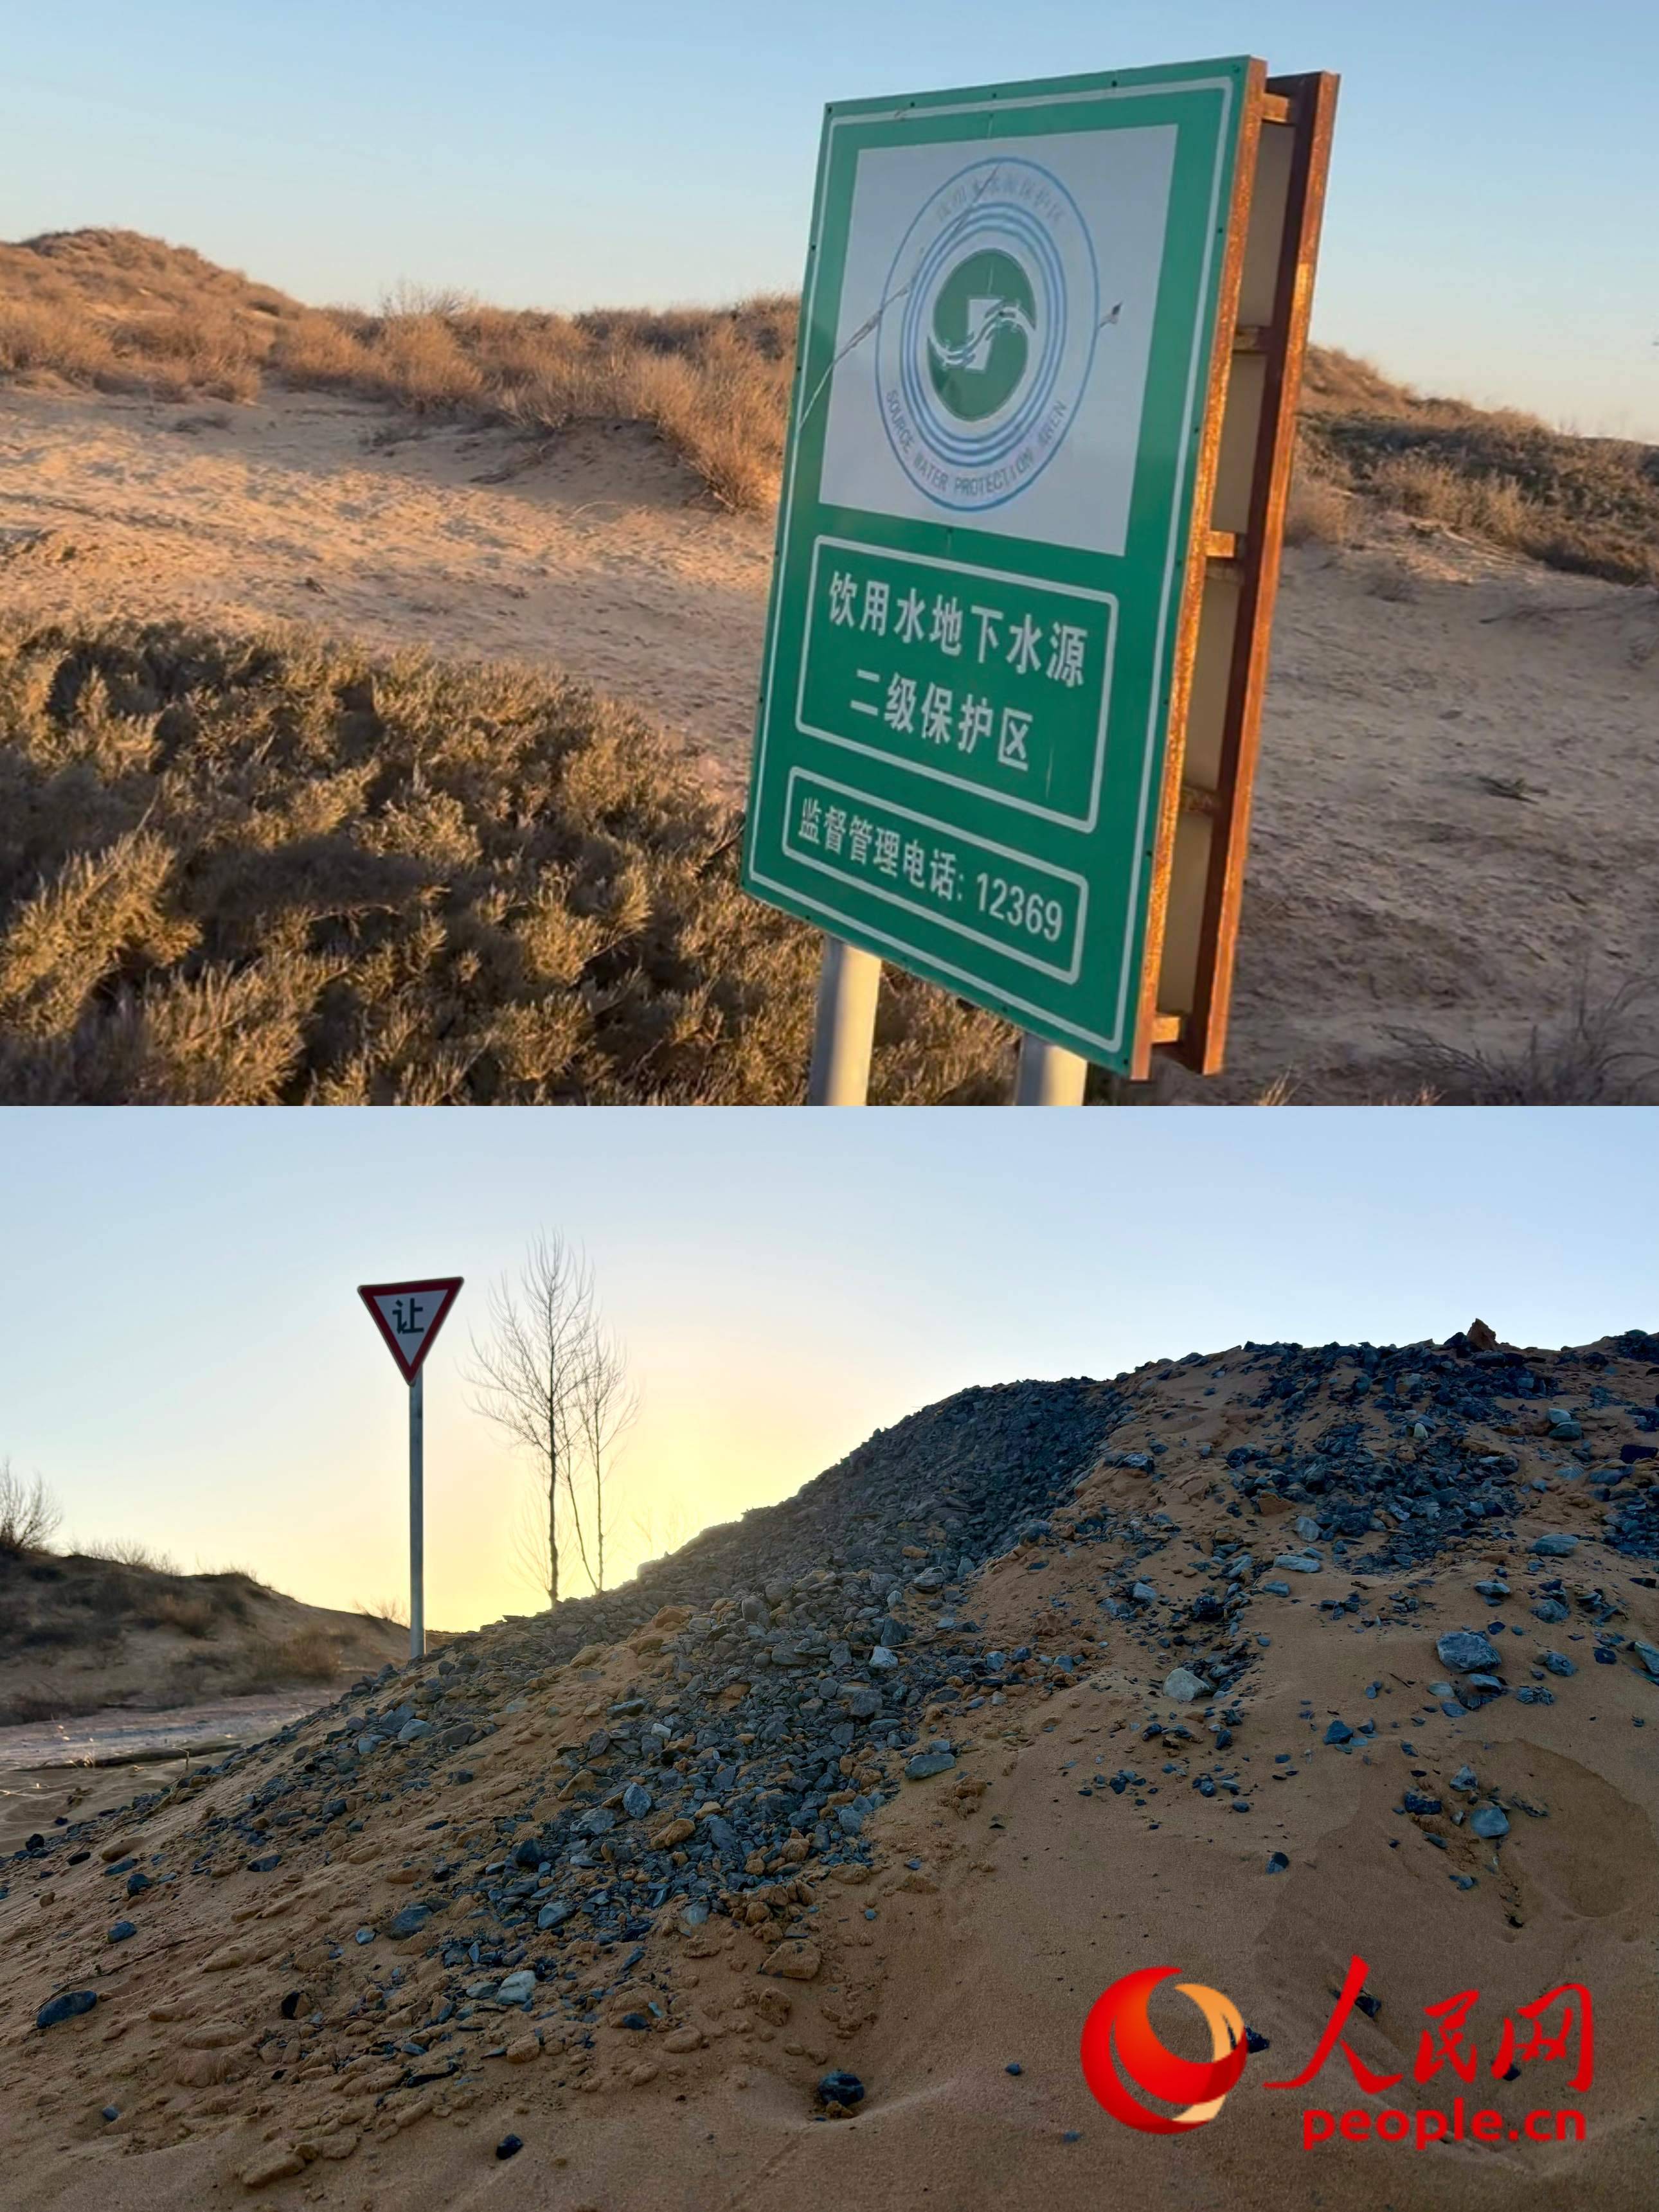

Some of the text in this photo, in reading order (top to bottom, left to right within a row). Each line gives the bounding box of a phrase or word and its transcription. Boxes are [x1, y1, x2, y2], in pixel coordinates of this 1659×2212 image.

[886, 389, 914, 454] SOURCE
[913, 452, 948, 492] WATER
[953, 447, 1035, 497] PROTECTION
[829, 571, 1088, 688] 饮用水地下水源
[850, 668, 1033, 772] 二级保护区
[976, 872, 1063, 942] 12369
[392, 1298, 424, 1334] 让
